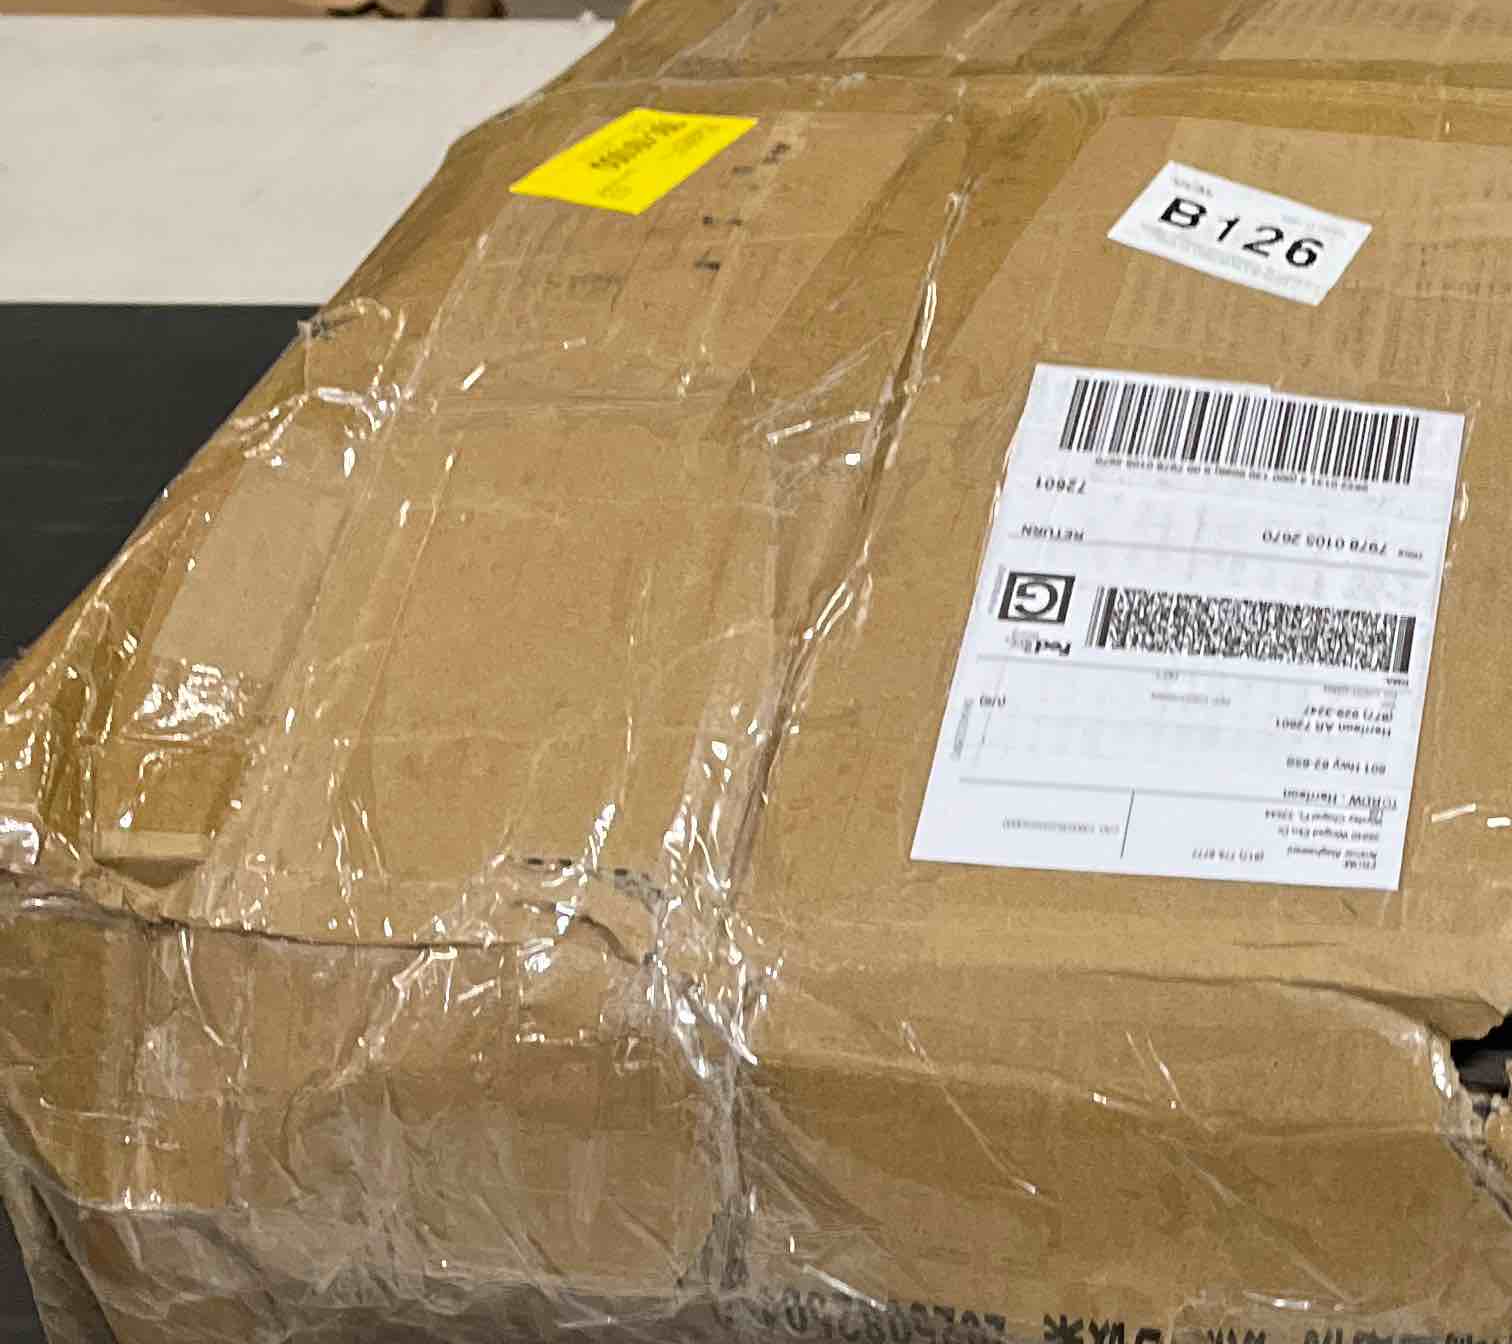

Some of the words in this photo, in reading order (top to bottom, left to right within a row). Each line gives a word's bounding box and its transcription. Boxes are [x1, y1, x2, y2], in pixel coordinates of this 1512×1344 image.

[1158, 197, 1324, 268] B126
[1035, 476, 1086, 496] 72601
[1021, 524, 1085, 543] RETURN
[1014, 582, 1059, 617] G
